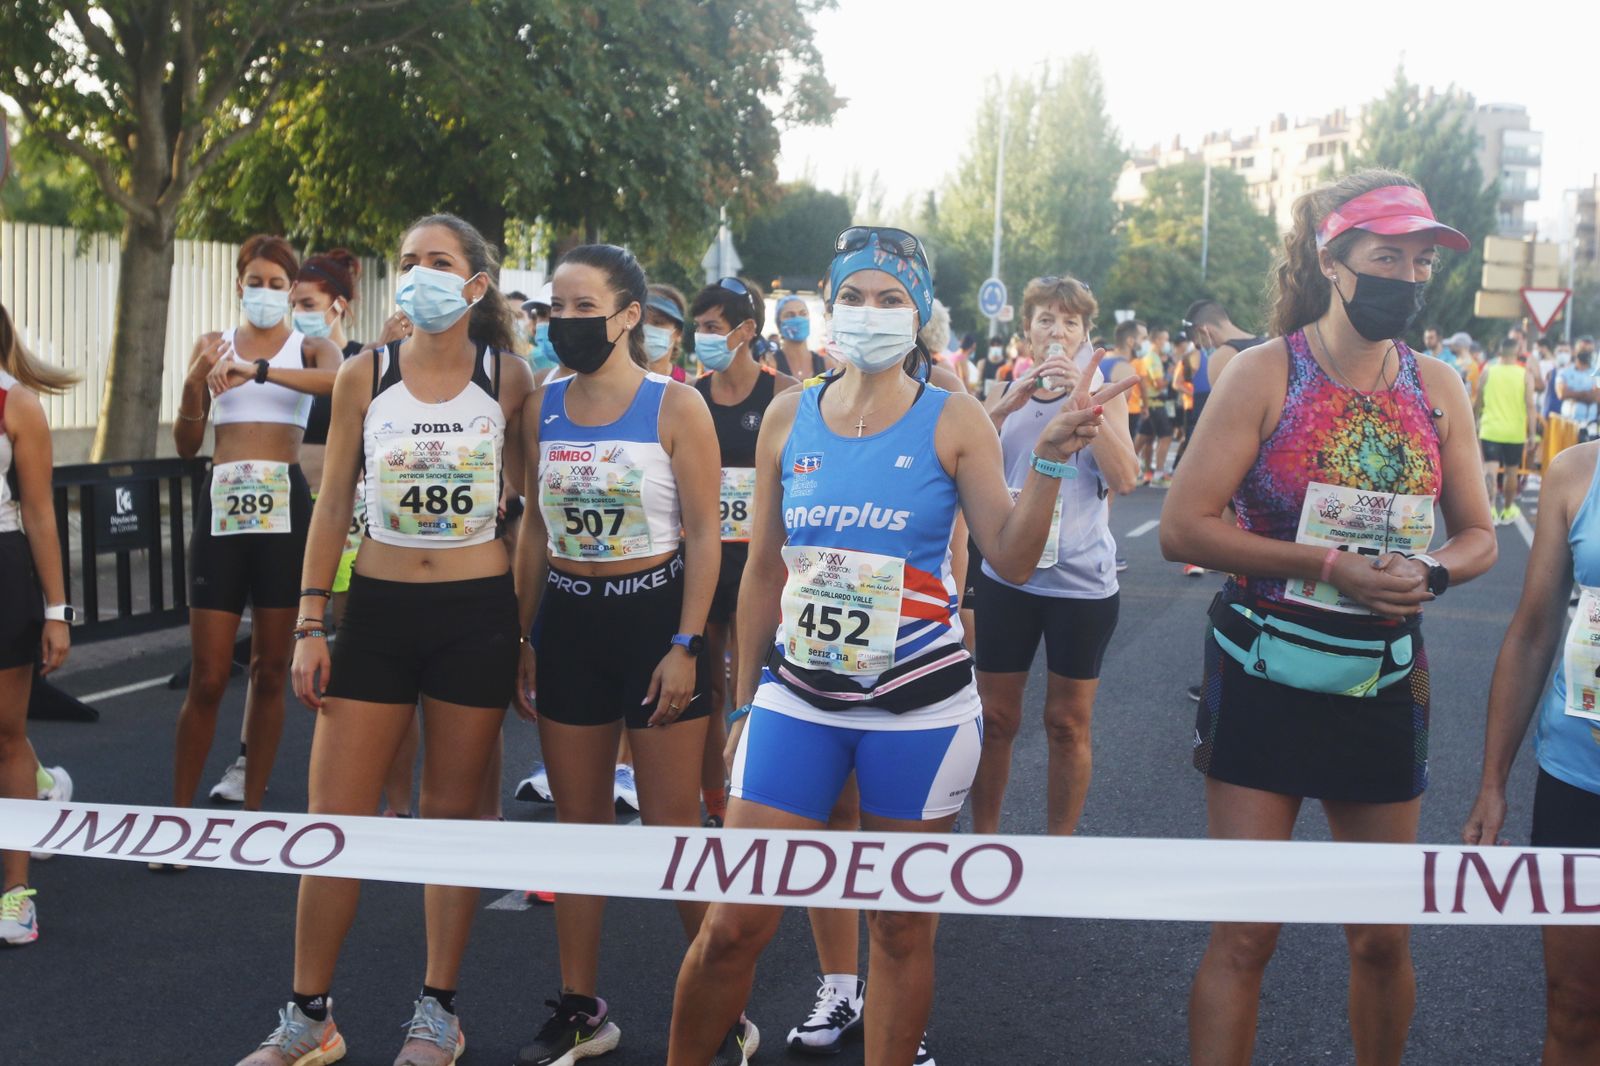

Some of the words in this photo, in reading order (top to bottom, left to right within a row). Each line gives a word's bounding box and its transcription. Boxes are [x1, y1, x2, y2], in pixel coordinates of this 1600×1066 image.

[415, 441, 444, 451] XXXV
[549, 450, 592, 462] BIMBO
[570, 466, 596, 476] XXXV
[227, 494, 274, 516] 289
[400, 485, 474, 515] 486
[1356, 494, 1392, 508] XXXV
[564, 508, 625, 538] 507
[786, 502, 911, 532] enerplus
[1319, 510, 1338, 520] VAR
[1330, 529, 1356, 537] MARINA
[1358, 532, 1373, 540] LORA
[1374, 534, 1384, 542] DE
[1394, 536, 1411, 544] VEGA
[548, 570, 592, 596] PRO
[604, 568, 668, 597] NIKE
[801, 586, 820, 596] CARMEN
[820, 590, 851, 600] GALLARDO
[853, 595, 872, 604] VALLE
[798, 602, 870, 646] 452
[808, 647, 849, 662] serizona
[34, 808, 346, 871] IMDECO
[660, 835, 1024, 906] IMDECO
